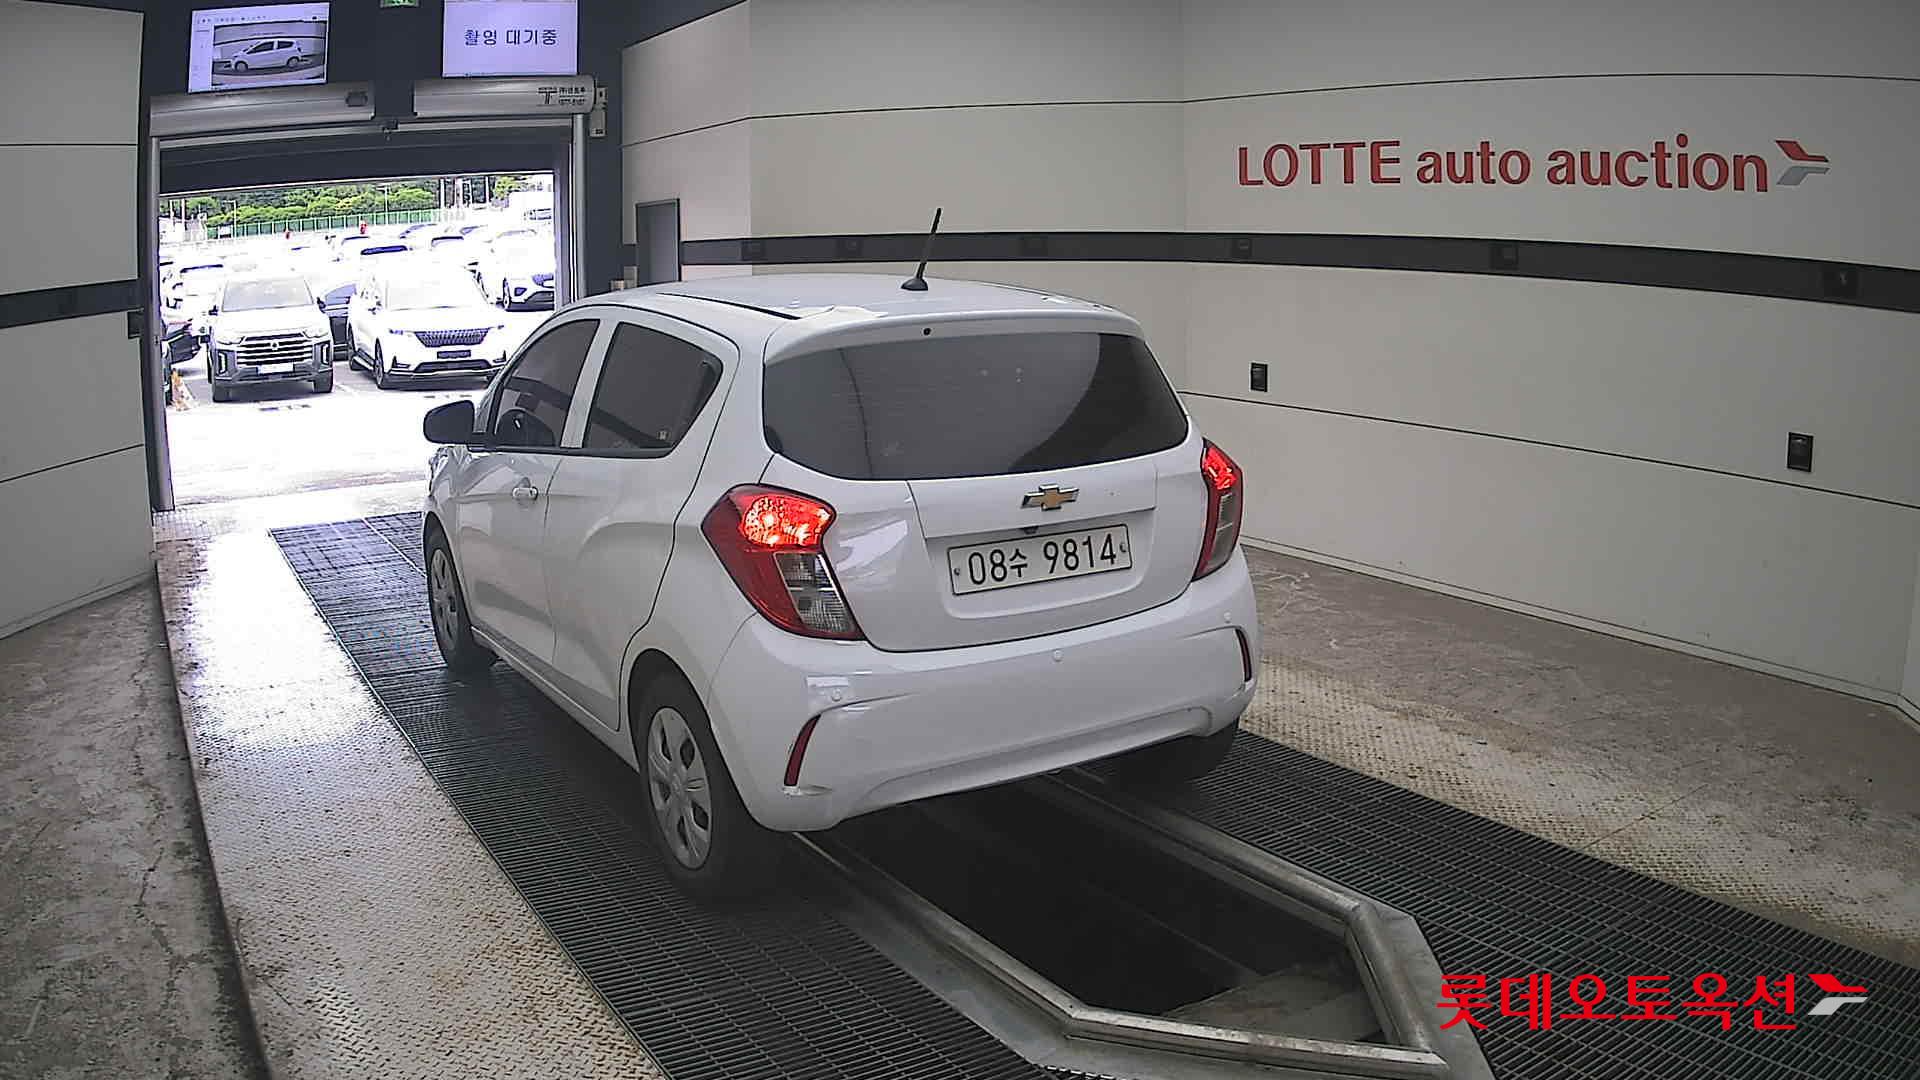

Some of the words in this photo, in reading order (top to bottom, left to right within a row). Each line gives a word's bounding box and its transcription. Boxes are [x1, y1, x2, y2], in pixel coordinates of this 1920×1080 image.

[464, 29, 498, 46] 촬영
[506, 29, 558, 46] 대기중
[1238, 140, 1401, 186] LOTTE
[1416, 141, 1531, 185] auto
[1547, 133, 1768, 192] auction
[968, 548, 1028, 585] 08수
[1043, 533, 1117, 574] 9814
